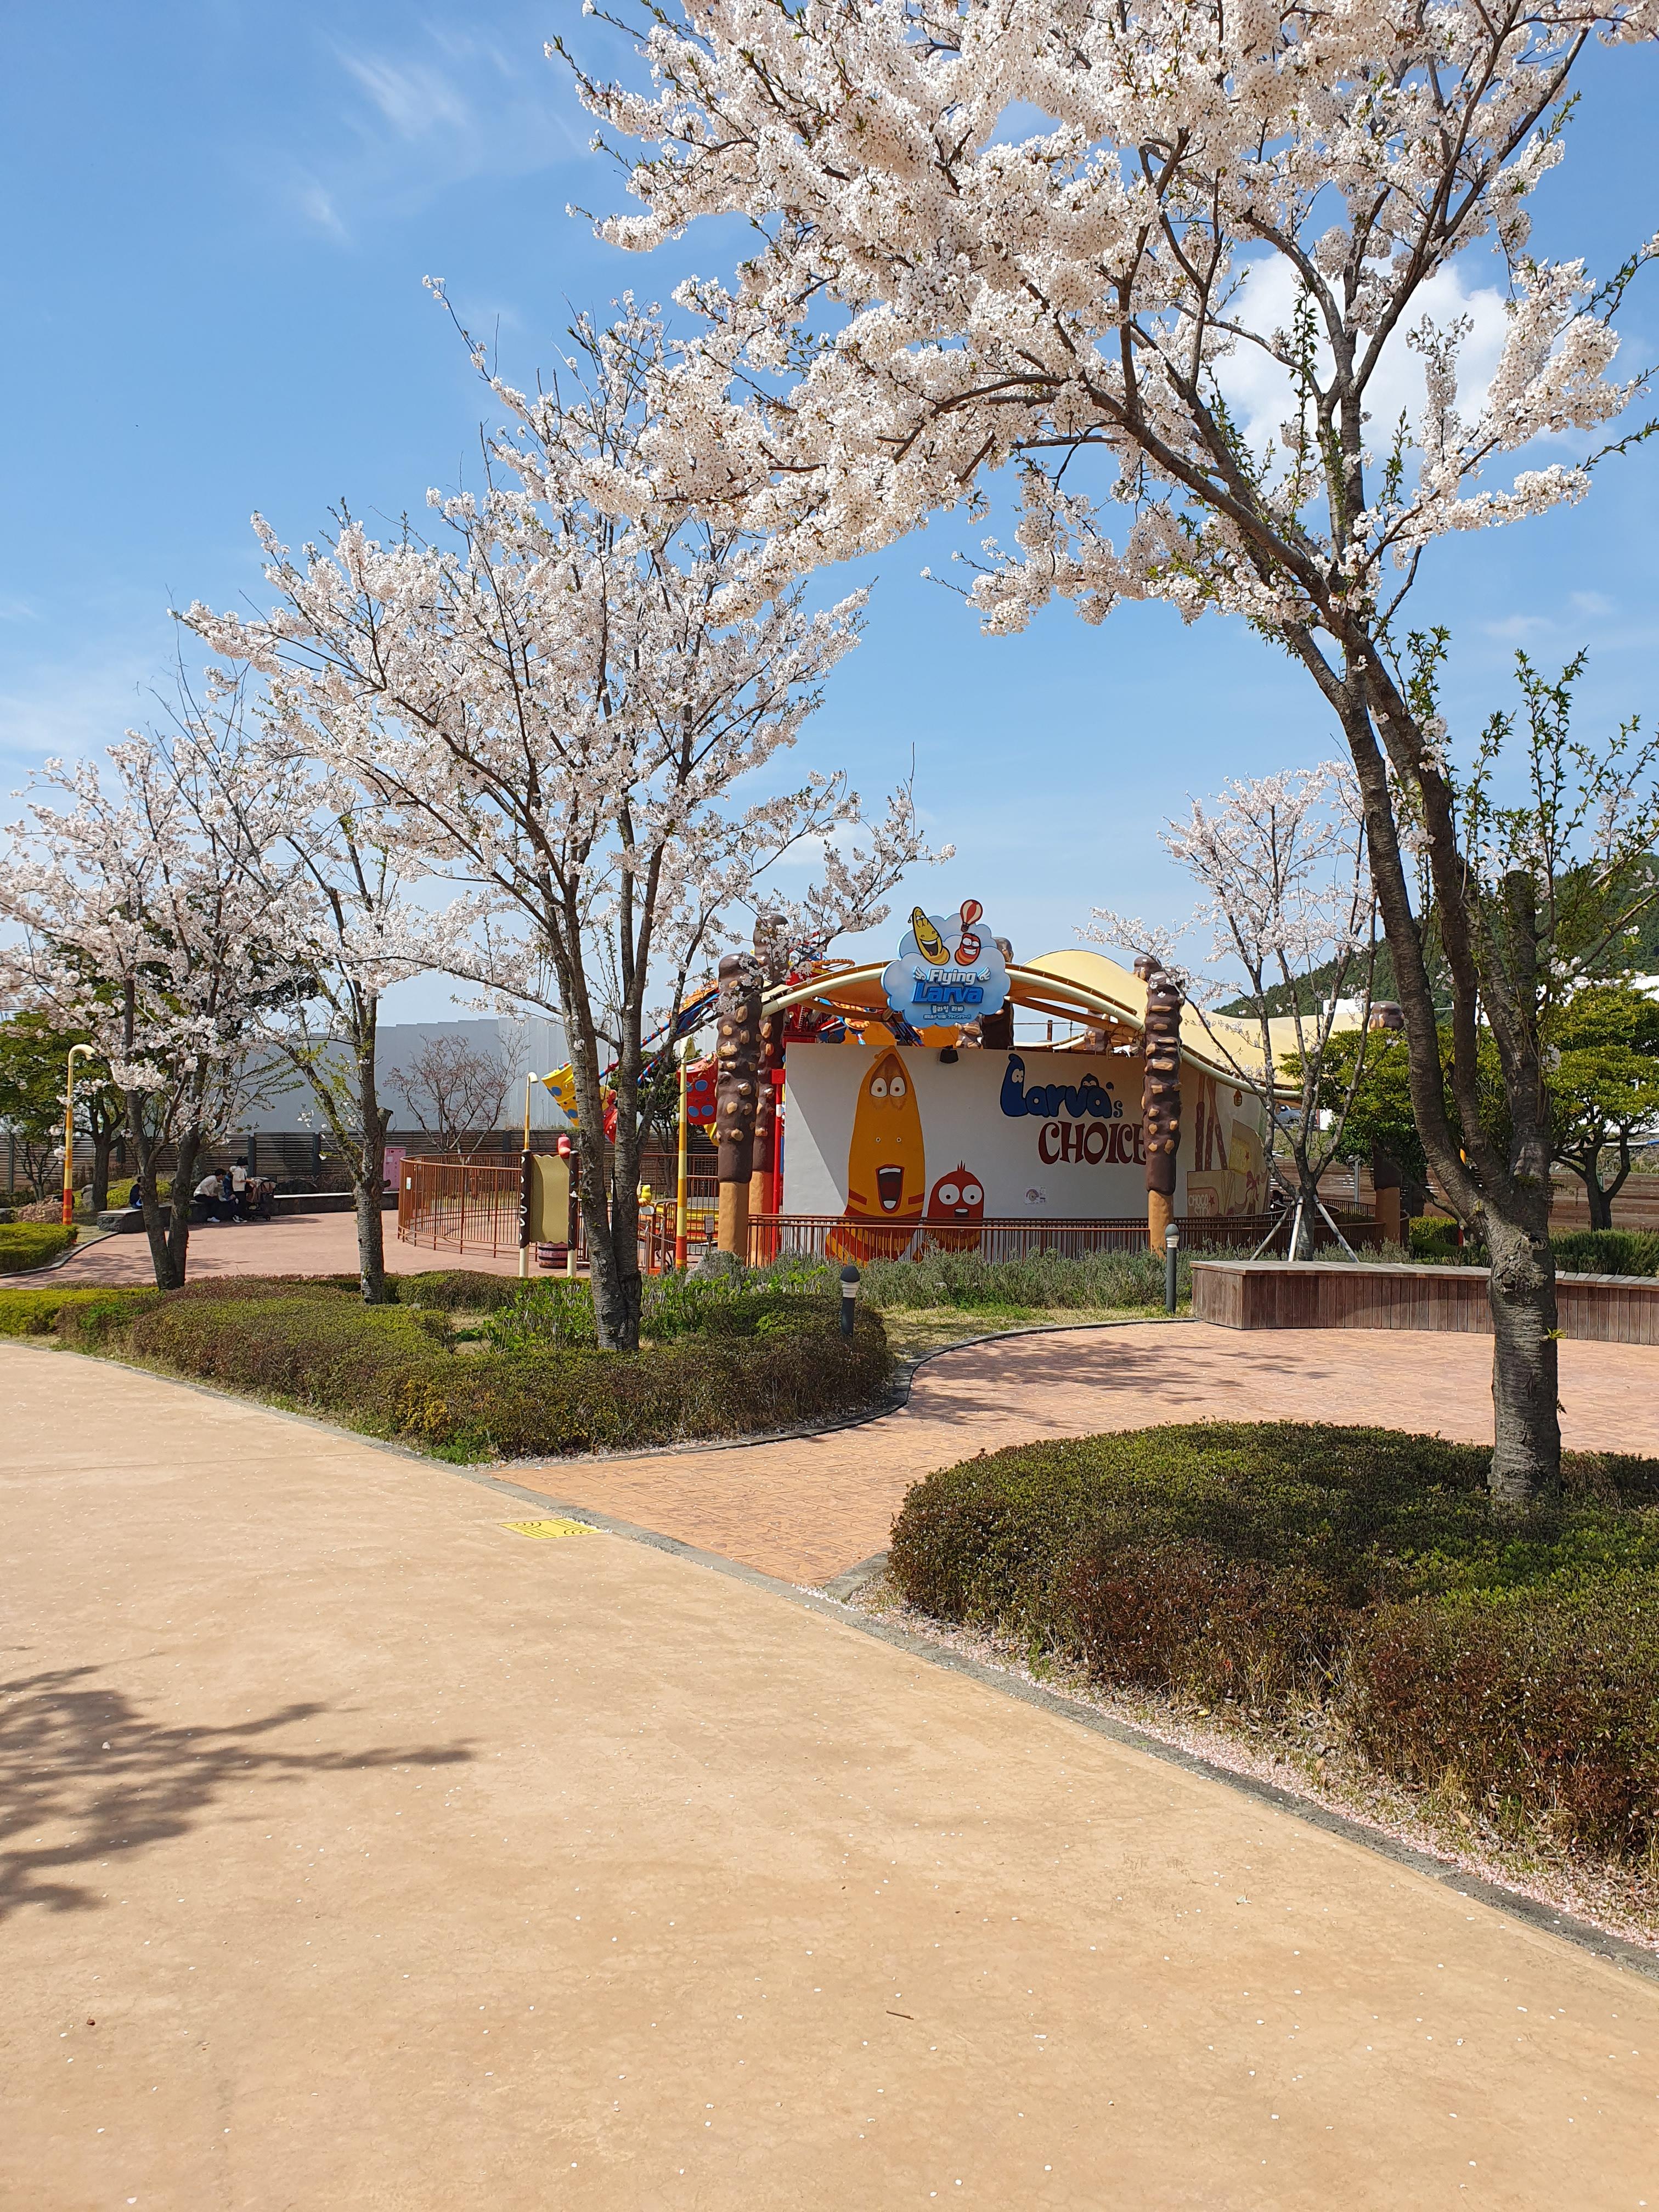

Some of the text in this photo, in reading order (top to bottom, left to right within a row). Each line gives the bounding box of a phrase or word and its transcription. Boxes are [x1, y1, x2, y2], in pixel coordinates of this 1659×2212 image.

[928, 969, 977, 986] Flying
[912, 981, 984, 1003] Larva
[932, 1005, 949, 1013] 플라잉
[1000, 1053, 1123, 1119] Larva's
